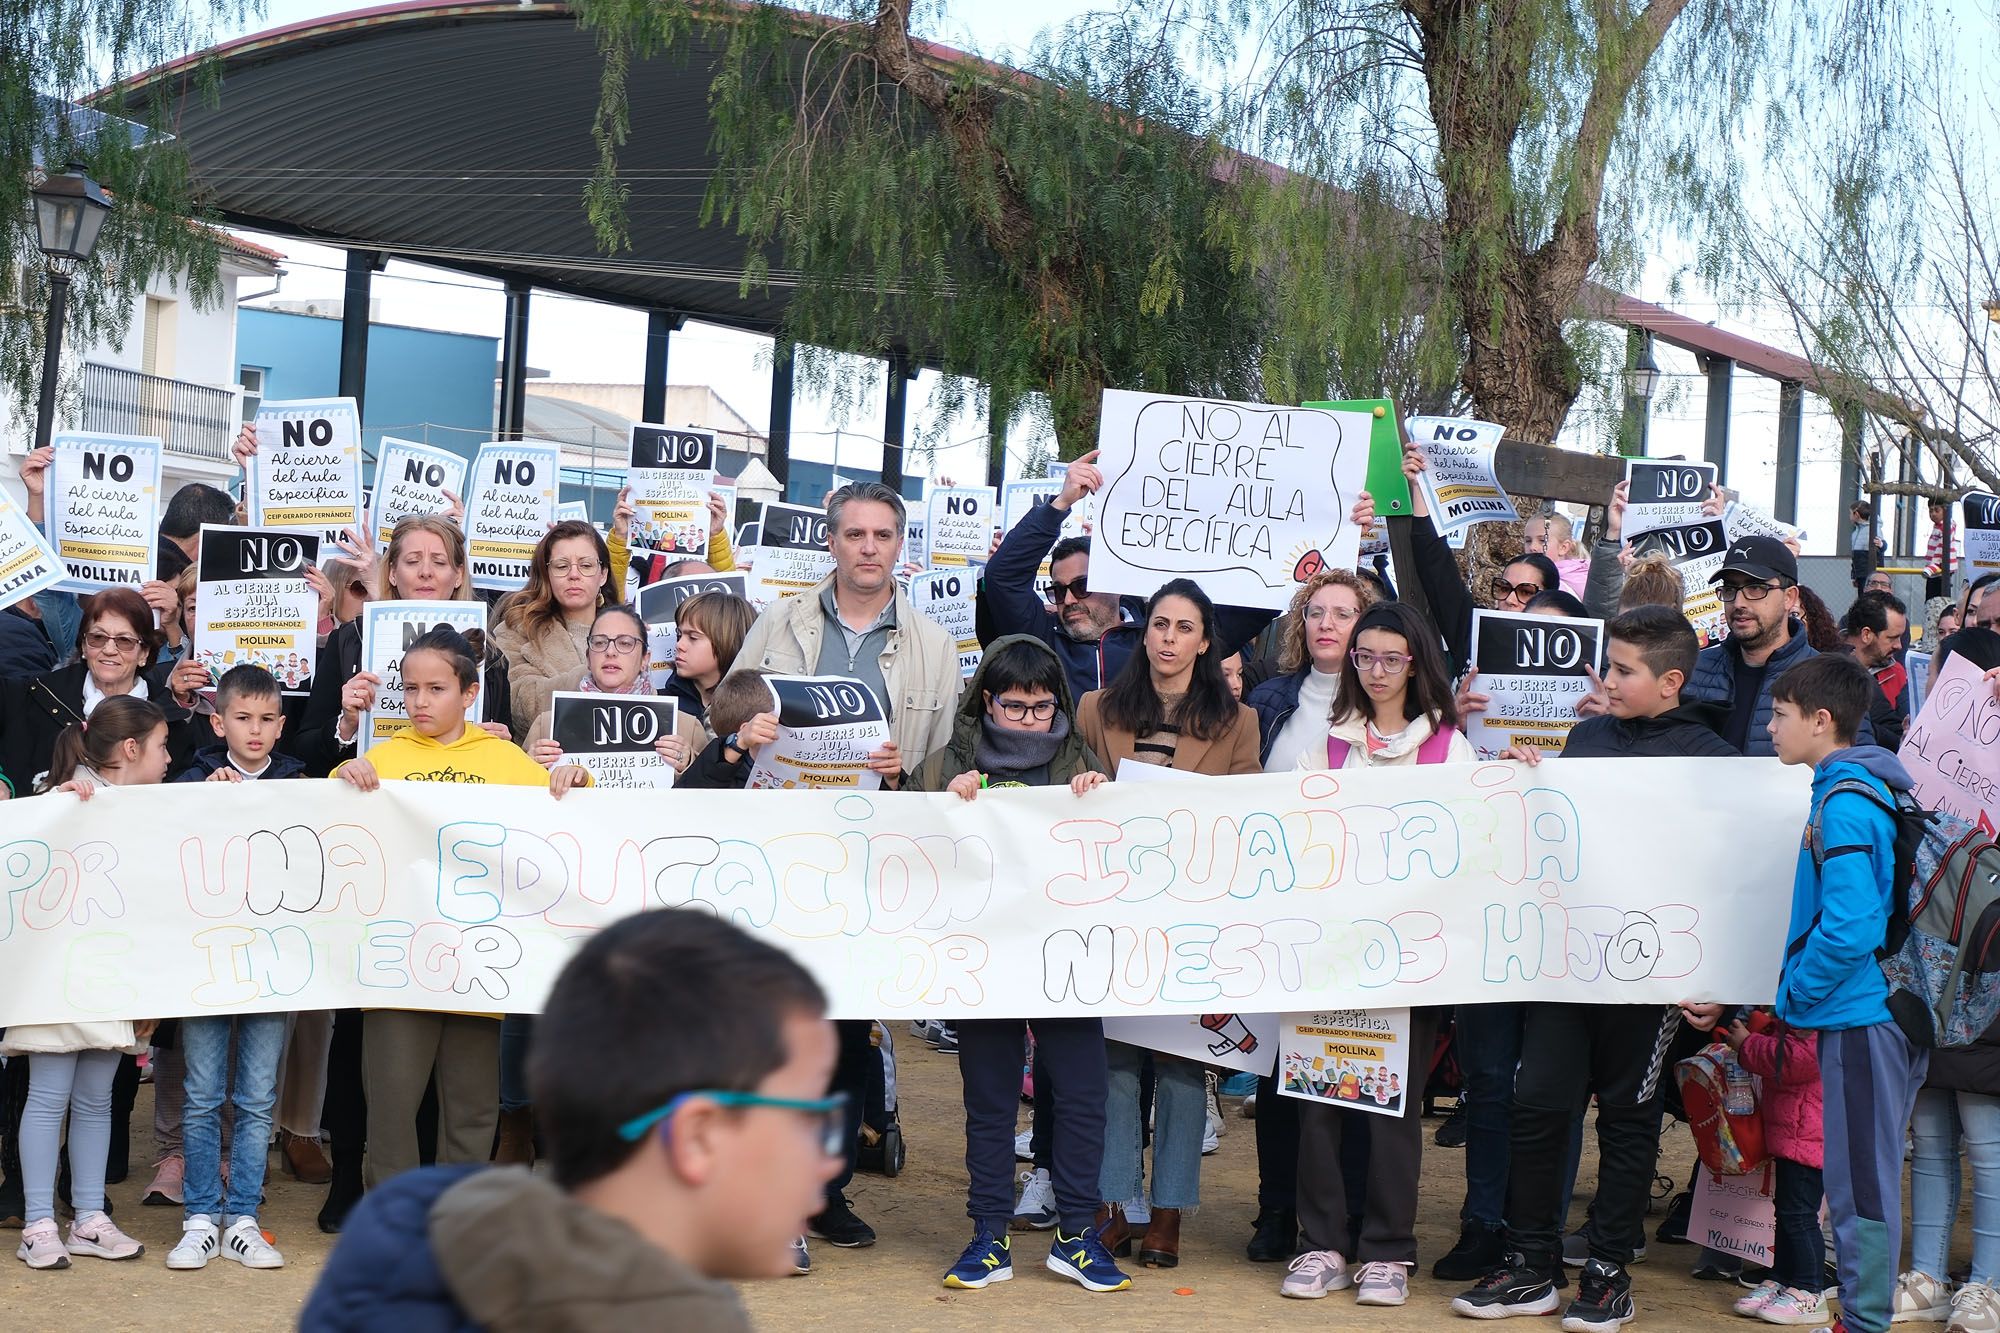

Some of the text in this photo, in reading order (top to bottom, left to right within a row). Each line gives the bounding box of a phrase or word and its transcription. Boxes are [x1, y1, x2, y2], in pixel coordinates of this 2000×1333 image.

[282, 419, 333, 448] NO
[1182, 404, 1304, 449] NO AL
[1433, 425, 1477, 441] NO
[657, 435, 703, 464] NO
[1428, 445, 1478, 456] Al cierre
[272, 452, 341, 466] Al cierre
[1159, 440, 1275, 481] CIERRE
[1433, 457, 1479, 469] del Aula
[82, 452, 134, 482] NO
[404, 458, 446, 488] NO
[494, 459, 536, 487] NO
[272, 469, 341, 483] del Aula
[640, 471, 705, 481] AL CIERRE DEL
[1435, 471, 1488, 483] Específica
[1657, 468, 1702, 498] NO
[659, 480, 683, 489] AULA
[68, 485, 139, 503] Al cierre
[269, 487, 348, 504] Específica
[391, 484, 445, 505] Al cierre
[482, 490, 541, 505] Al cierre
[645, 487, 699, 498] ESPECÍFICA
[1142, 475, 1200, 513] DEL
[1225, 483, 1305, 523] AULA
[68, 501, 137, 521] del Aula
[389, 498, 409, 512] del
[947, 496, 978, 516] NO
[1448, 501, 1507, 518] MOLLINA
[1637, 505, 1649, 515] AL
[1652, 505, 1685, 515] CIERRE
[314, 510, 352, 519] FERNÁNDEZ
[481, 505, 538, 521] del Aula
[654, 511, 688, 519] MOLLINA
[1660, 514, 1683, 523] AULA
[938, 517, 982, 528] Al cierre
[1737, 517, 1753, 532] del
[1742, 508, 1755, 520] Al
[1755, 516, 1784, 536] cierre
[64, 521, 143, 540] Específica
[476, 522, 544, 540] Específica
[789, 515, 828, 546] NO
[938, 527, 981, 540] del Aula
[1121, 513, 1272, 561] ESPECÍFICA
[935, 540, 983, 552] Específica
[1659, 526, 1713, 560] NO
[77, 547, 107, 556] GERARDO
[108, 549, 146, 559] FERNÁNDEZ
[240, 537, 303, 573] NO
[769, 549, 780, 559] AL
[784, 551, 816, 562] CIERRE
[818, 555, 837, 563] DEL
[790, 561, 813, 571] AULA
[1704, 556, 1724, 568] DEL
[66, 564, 142, 584] MOLLINA
[473, 562, 531, 577] MOLLIN
[774, 568, 827, 580] ESPECÍFIC
[214, 582, 308, 595] AL CIERRE DEL
[931, 576, 960, 600] NO
[246, 595, 278, 605] AULA
[224, 605, 300, 618] ESPECÍFICA
[925, 601, 968, 615] Al cierre
[945, 612, 969, 625] Aula
[656, 626, 670, 637] AL
[240, 637, 287, 645] MOLLINA
[1516, 627, 1582, 669] NO
[386, 676, 404, 691] de
[1489, 679, 1586, 692] AL CIERRE DEL
[805, 683, 866, 718] NO
[1520, 693, 1553, 704] AULA
[1500, 704, 1577, 718] ESPECÍFICA
[593, 705, 658, 745] NO
[1958, 695, 2000, 746] NO
[789, 726, 880, 741] AL CIERRE DEL
[818, 741, 851, 751] AULA
[1514, 736, 1561, 746] MOLLINA
[1905, 725, 1931, 762] AL
[588, 756, 636, 768] CIERRE
[640, 756, 664, 767] DEL
[794, 750, 871, 761] ESPECÍFICA
[600, 769, 632, 781] AULA
[803, 774, 851, 783] MOLLINA
[0, 839, 126, 942] POR
[180, 824, 387, 918] UNA
[1044, 911, 1448, 1005] NUESTROS
[1312, 1013, 1390, 1030] ESPECÍFICA
[1316, 1028, 1349, 1036] GERARDO
[1329, 1045, 1376, 1057] MOLLINA
[1709, 1208, 1729, 1219] CEIP
